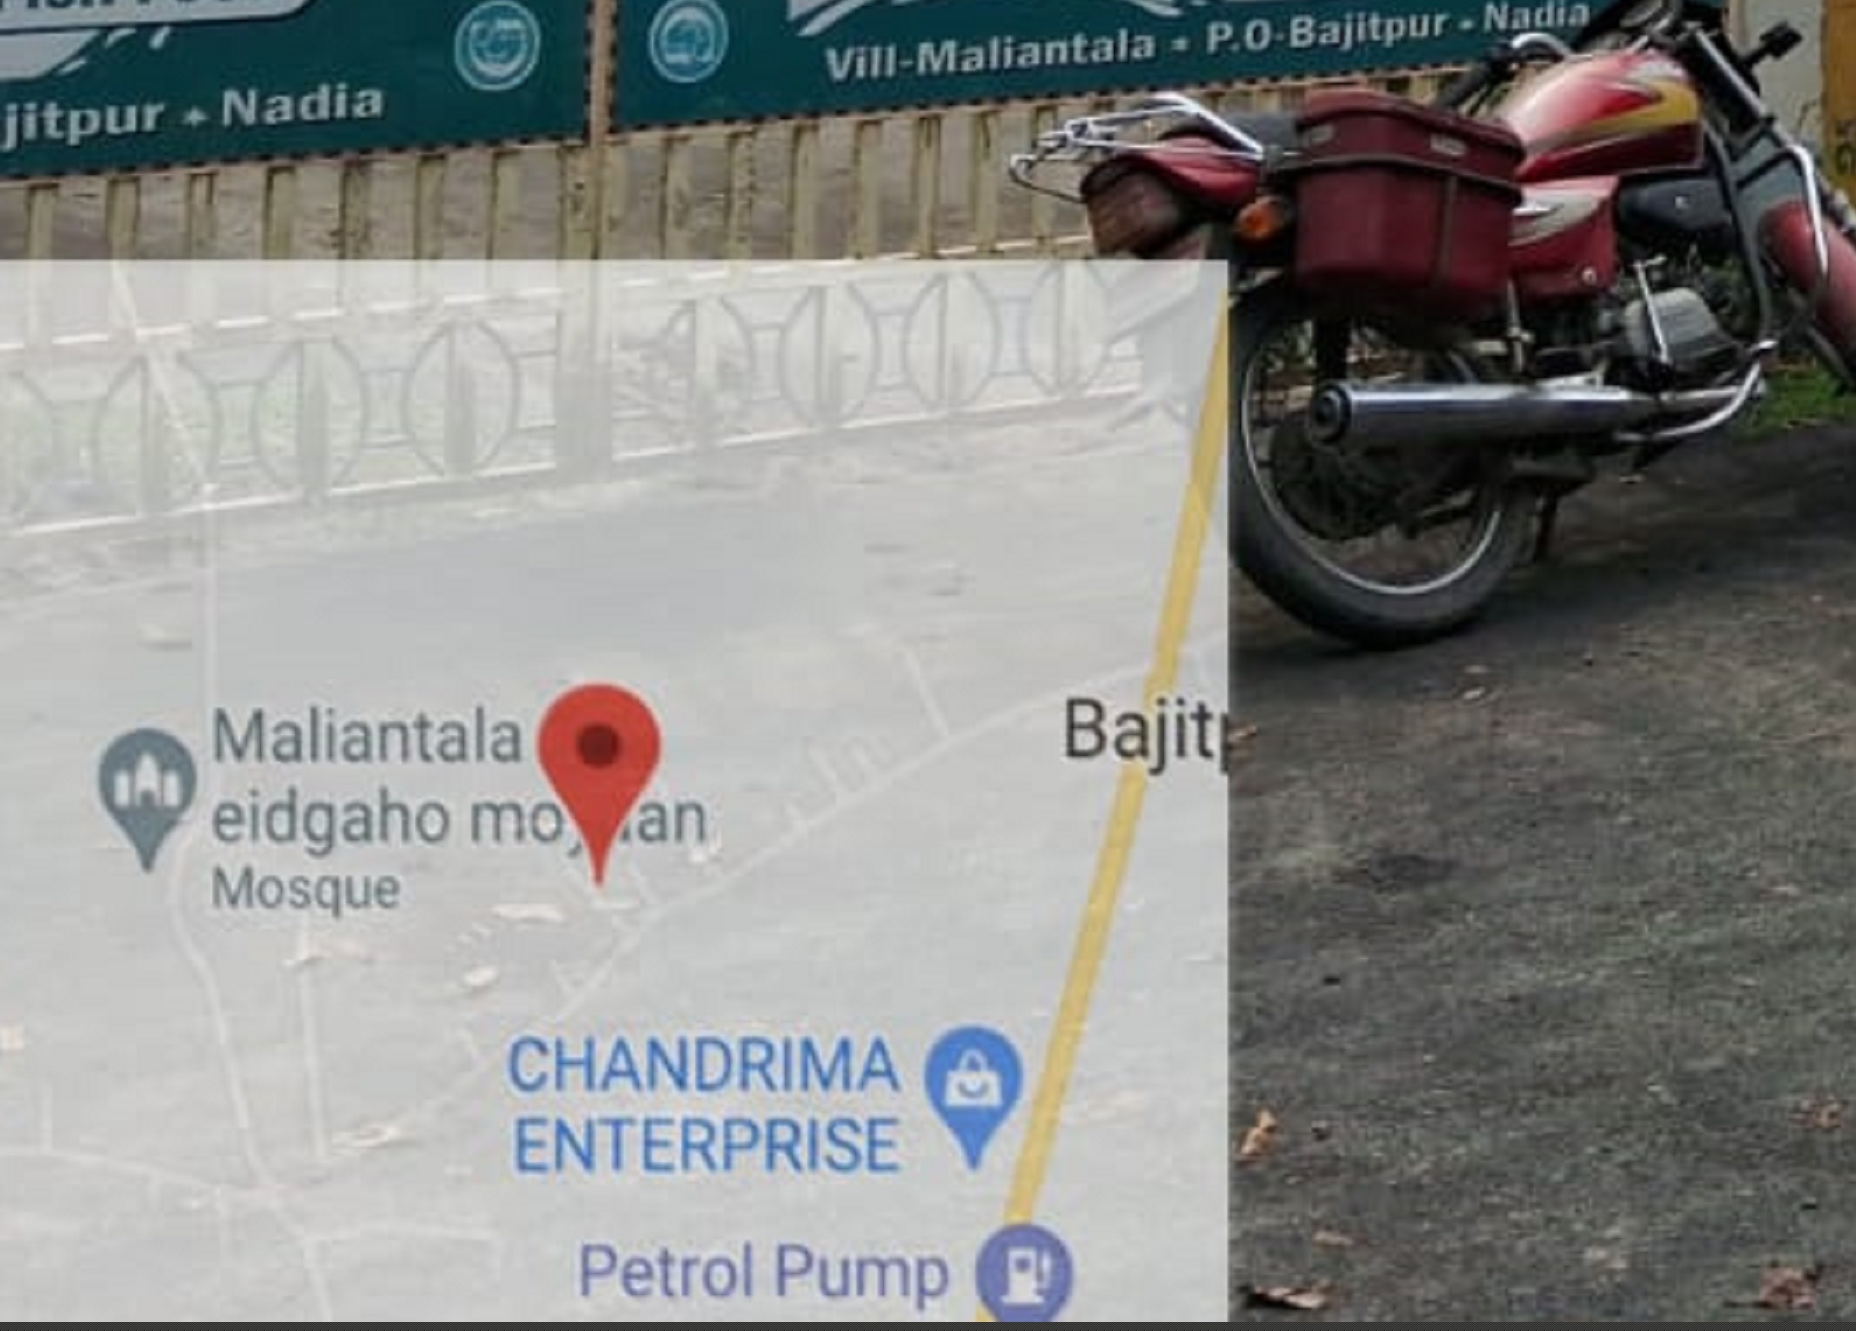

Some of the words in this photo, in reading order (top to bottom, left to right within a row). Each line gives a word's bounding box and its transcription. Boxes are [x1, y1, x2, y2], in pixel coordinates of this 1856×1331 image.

[826, 28, 1156, 83] Vill-Maliantala
[1205, 12, 1448, 55] P.O-Bajitpur
[1484, 0, 1592, 31] Nadia
[222, 81, 385, 128] Nadia
